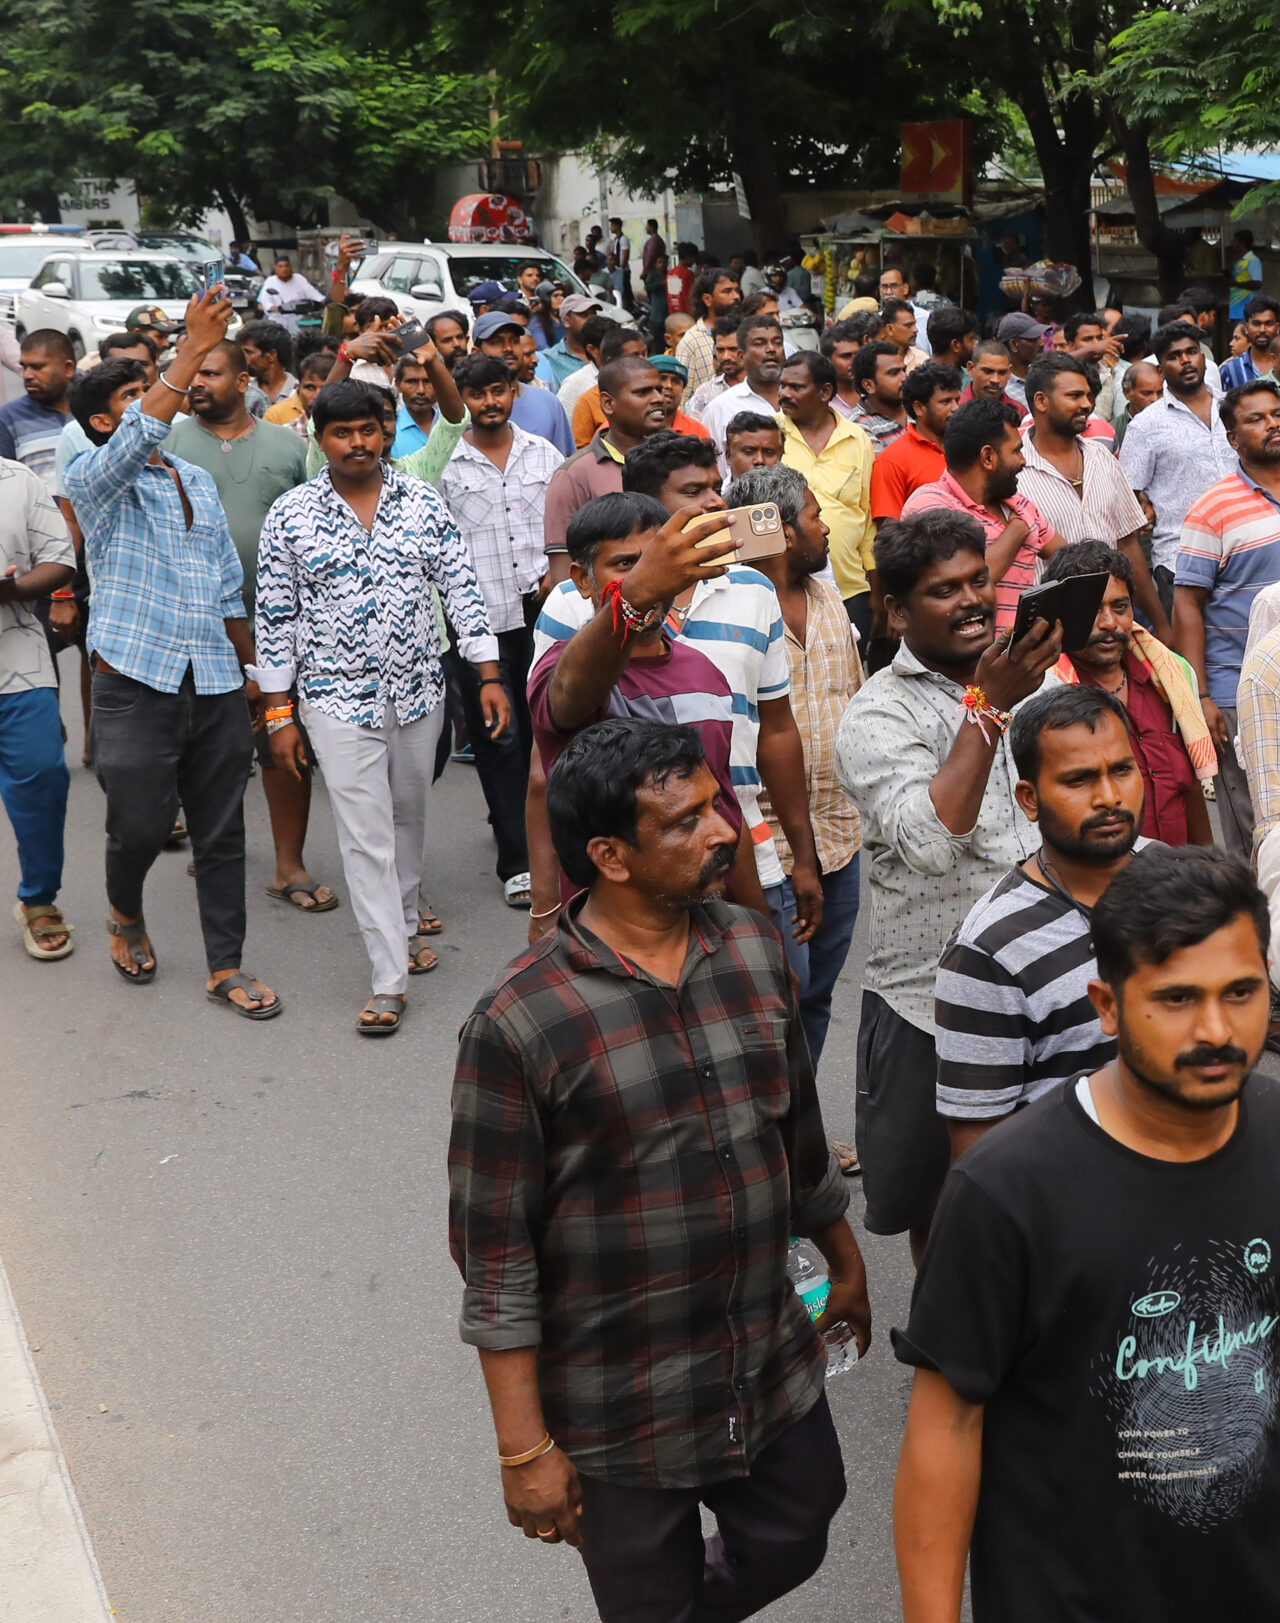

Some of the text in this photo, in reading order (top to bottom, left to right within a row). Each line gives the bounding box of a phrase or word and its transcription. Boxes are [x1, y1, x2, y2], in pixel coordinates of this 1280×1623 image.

[1116, 1315, 1280, 1391] Confidence
[1118, 1427, 1188, 1438] YOUR POWER TO
[1118, 1448, 1201, 1459] CHANGE YOURSELF
[1149, 1466, 1218, 1480] UNDERESTIMATE
